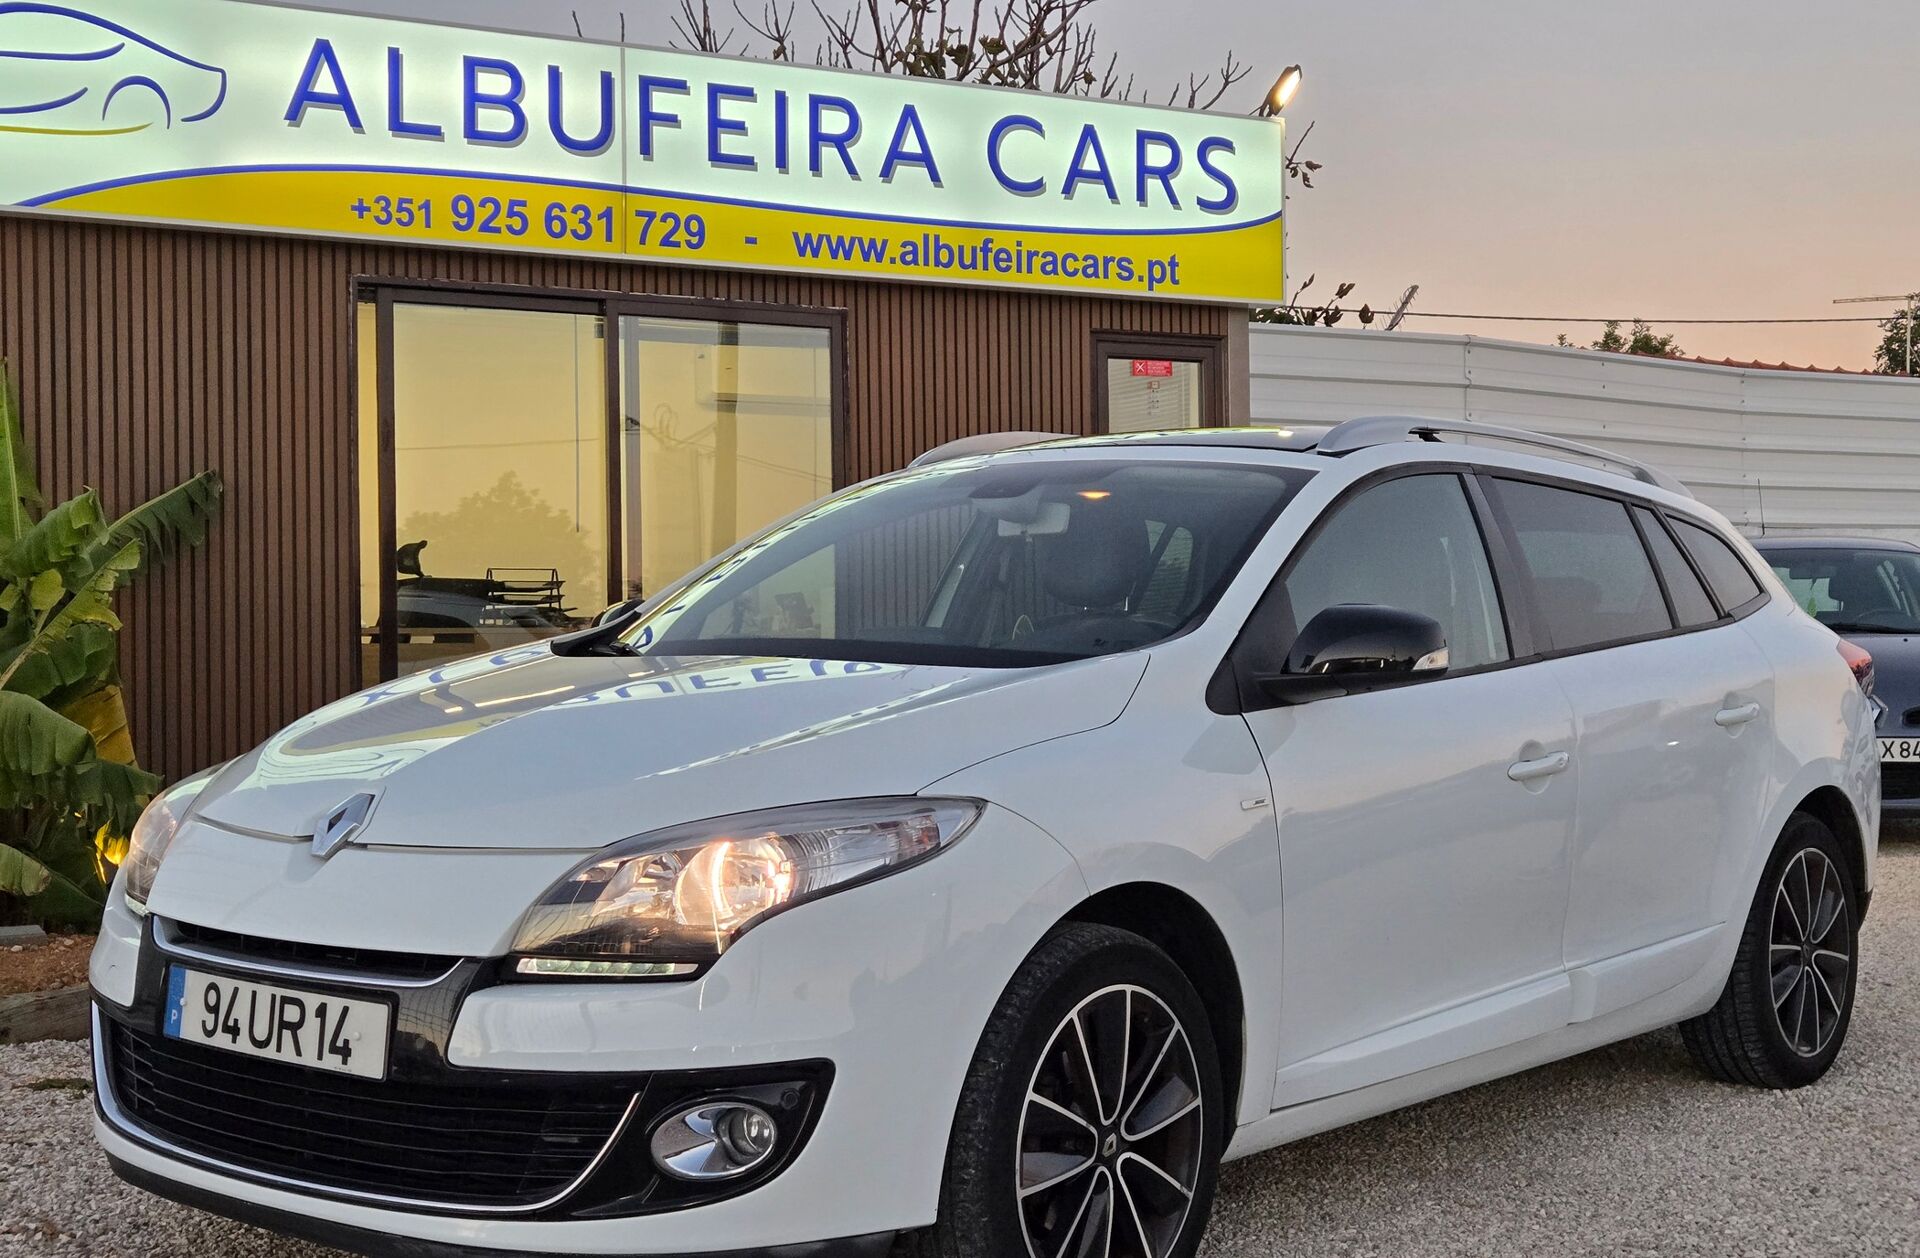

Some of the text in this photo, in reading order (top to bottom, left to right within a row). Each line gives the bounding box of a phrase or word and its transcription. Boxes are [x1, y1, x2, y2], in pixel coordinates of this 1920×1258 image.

[285, 38, 1239, 214] ALBUFEIRA CARS
[350, 195, 433, 230] +351
[451, 194, 529, 236] 925
[544, 201, 615, 242] 631
[636, 210, 706, 249] 729
[793, 230, 1180, 291] www.albufeiracars.pt
